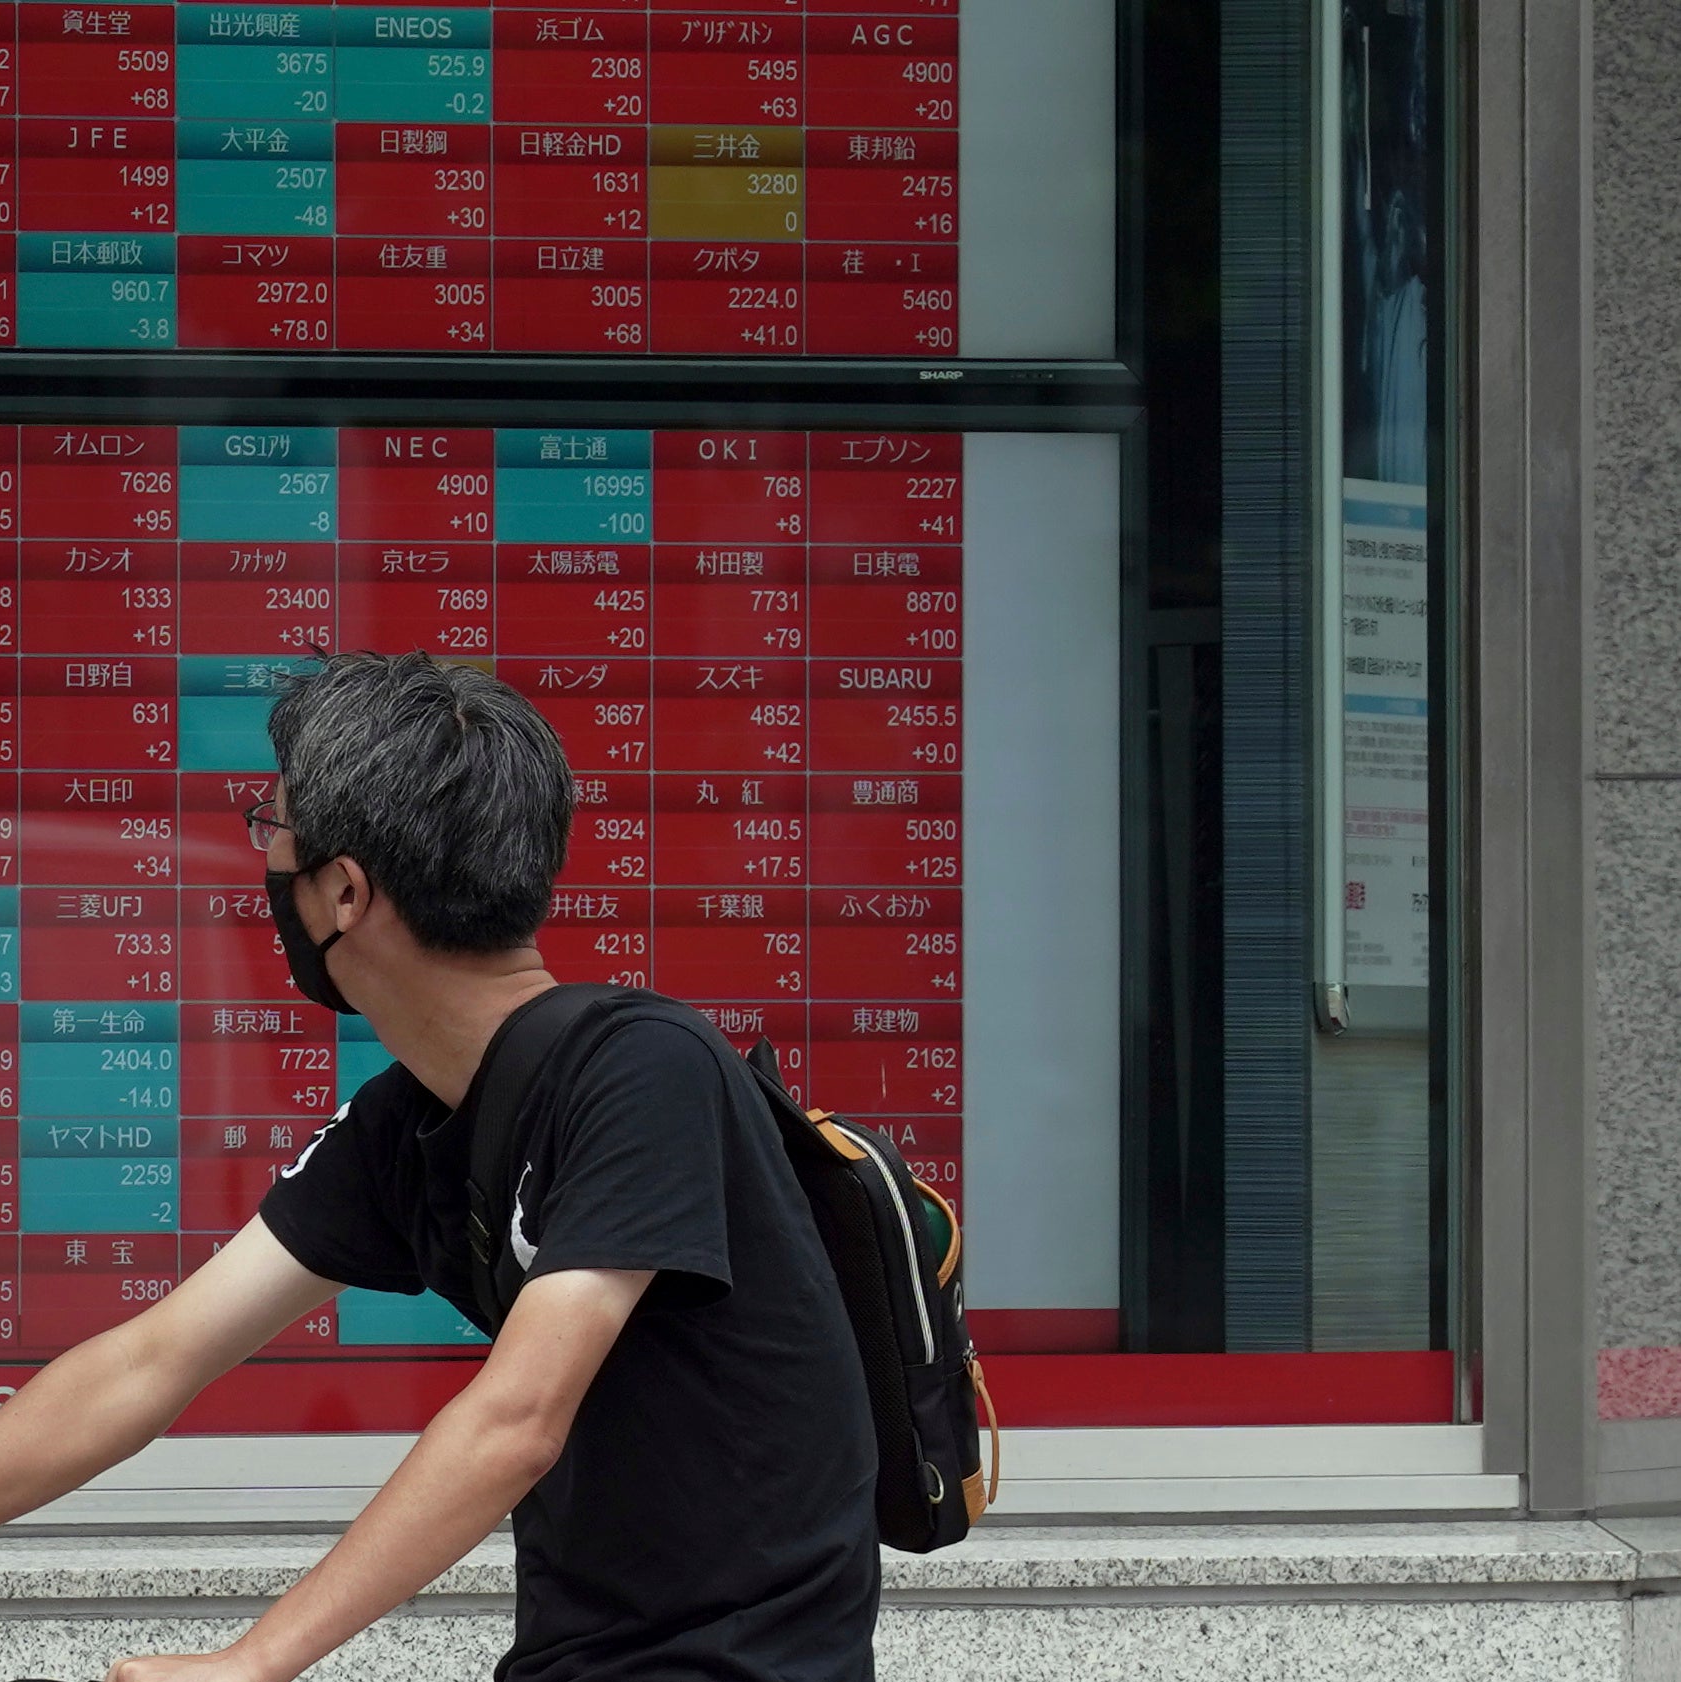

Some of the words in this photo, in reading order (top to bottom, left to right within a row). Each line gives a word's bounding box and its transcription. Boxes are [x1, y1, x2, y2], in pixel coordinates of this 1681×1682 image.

[62, 9, 132, 35] 資生堂
[536, 16, 605, 42] 浜ゴム
[428, 54, 485, 77] 525.9
[747, 59, 798, 81] 5495
[293, 90, 327, 112] -20
[220, 126, 290, 153] 大平金
[520, 131, 622, 157] 日軽金HD
[119, 165, 169, 187] 1499
[434, 169, 485, 191] 3230
[592, 171, 639, 193] 1631
[747, 173, 798, 195] 3280
[902, 175, 953, 197] 2475
[222, 244, 289, 267] コマツ
[693, 247, 760, 273] クボタ
[111, 279, 170, 302] 960.7
[591, 285, 642, 308] 3005
[902, 289, 953, 311] 5460
[446, 321, 486, 343] +34
[919, 370, 964, 381] SHARP
[53, 431, 145, 457] オムロン
[539, 434, 609, 461] 富士通
[840, 435, 931, 463] エプソン
[436, 474, 488, 496] 4900
[763, 476, 802, 498] 768
[309, 510, 330, 533] -8
[527, 549, 620, 575] 太陽誘電
[121, 587, 172, 609] 1333
[265, 587, 330, 610] 23400
[436, 588, 488, 611] 7869
[906, 590, 957, 613] 8870
[763, 627, 801, 649] +79
[696, 664, 764, 690] スズキ
[132, 702, 169, 724] 631
[593, 703, 646, 726] 3667
[887, 705, 957, 727] 2455.5
[593, 818, 646, 841] 3924
[733, 819, 802, 841] 1440.5
[133, 855, 172, 878] +34
[905, 856, 957, 878] +125
[56, 895, 142, 919] 三菱UFJ
[839, 893, 931, 918] ふくおか
[593, 933, 646, 956] 4213
[763, 933, 801, 955] 762
[52, 1007, 146, 1035] 第一生命
[851, 1006, 919, 1034] 東建物
[291, 1086, 331, 1108] +57
[120, 1164, 172, 1186] 2259
[304, 1315, 331, 1337] +8
